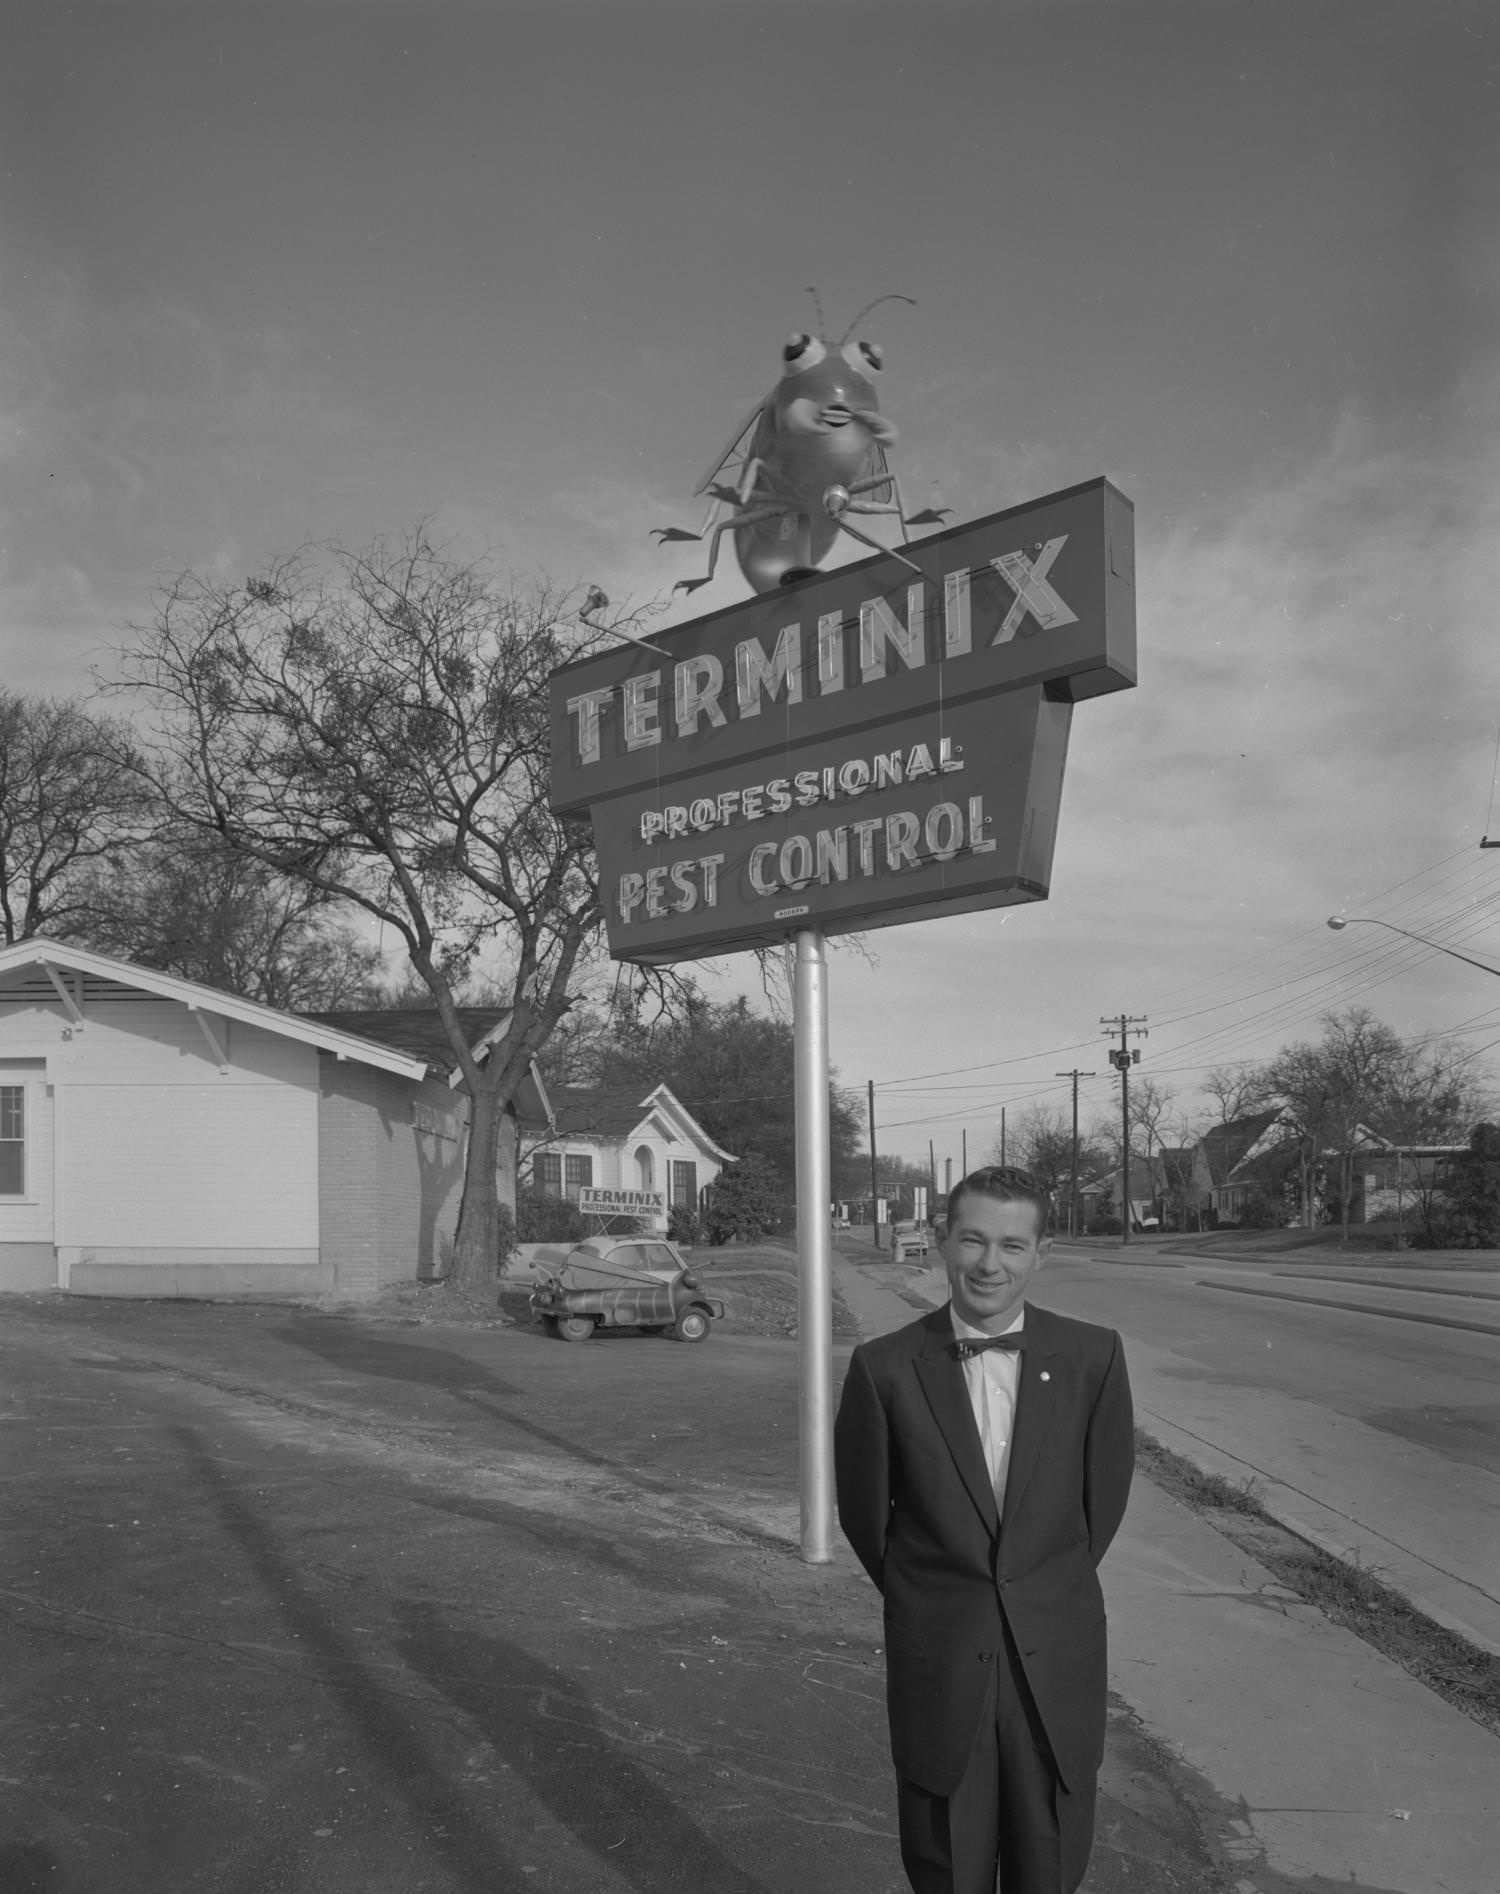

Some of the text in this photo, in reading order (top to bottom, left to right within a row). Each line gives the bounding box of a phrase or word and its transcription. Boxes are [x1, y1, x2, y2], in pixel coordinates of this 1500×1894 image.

[567, 534, 1079, 765] TERMINIX
[640, 737, 964, 844] PROFESSIONAL
[619, 796, 997, 924] PEST CONTROL
[582, 1189, 662, 1206] TERMINIX
